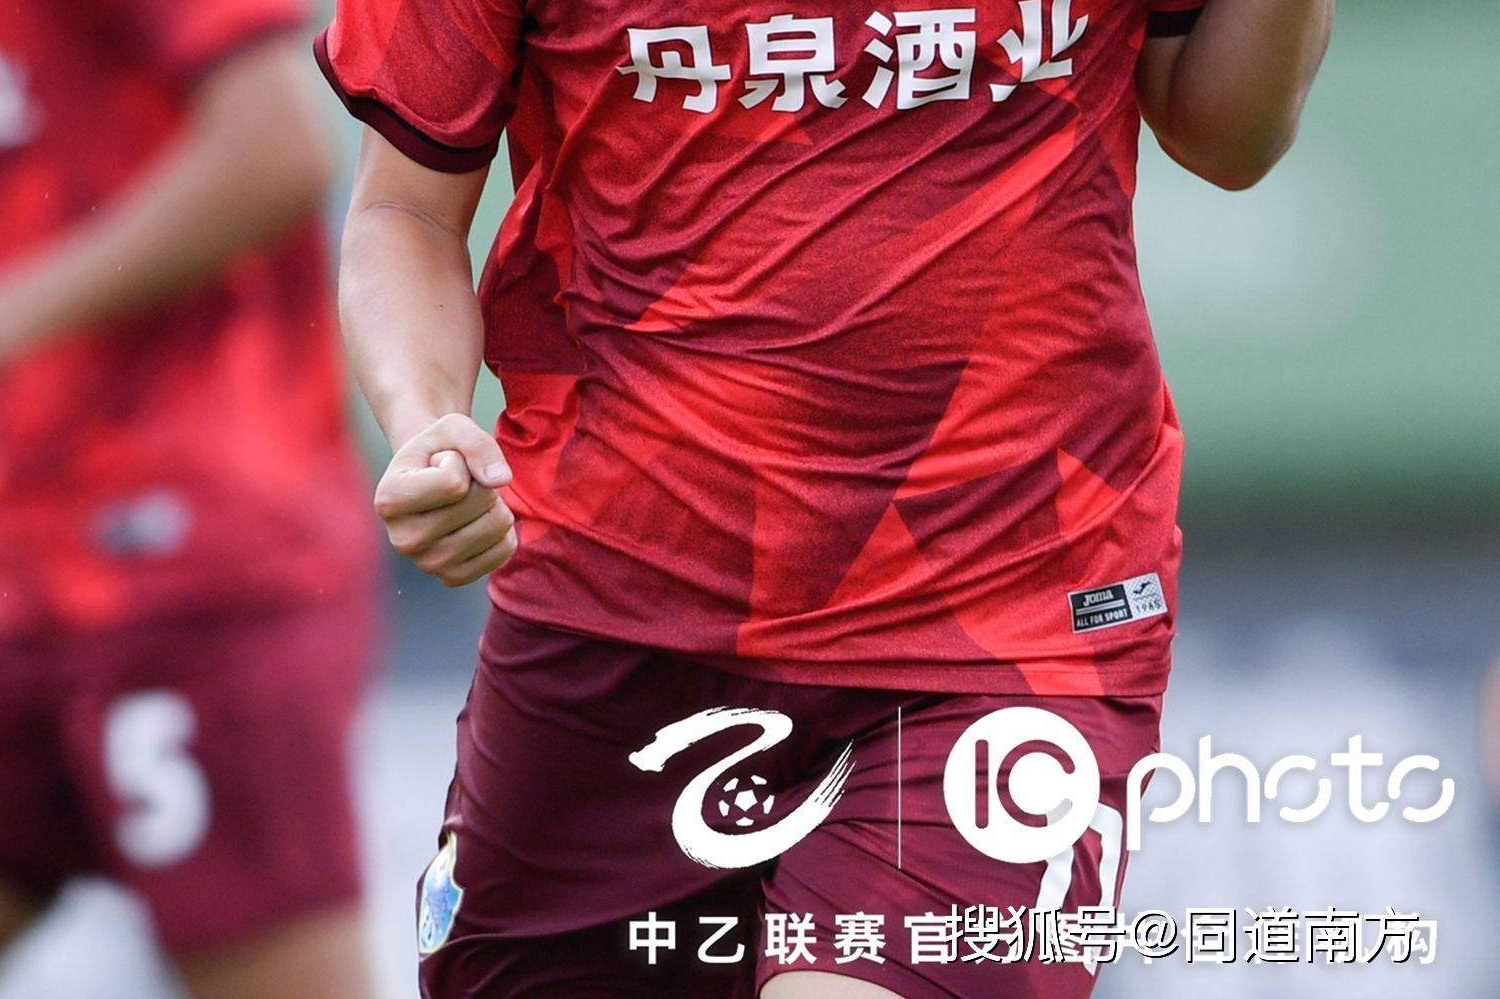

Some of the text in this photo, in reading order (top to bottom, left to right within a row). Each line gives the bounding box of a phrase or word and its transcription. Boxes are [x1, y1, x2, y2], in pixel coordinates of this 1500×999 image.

[1076, 608, 1129, 628] ALL FOR SPORT
[103, 687, 213, 868] 5
